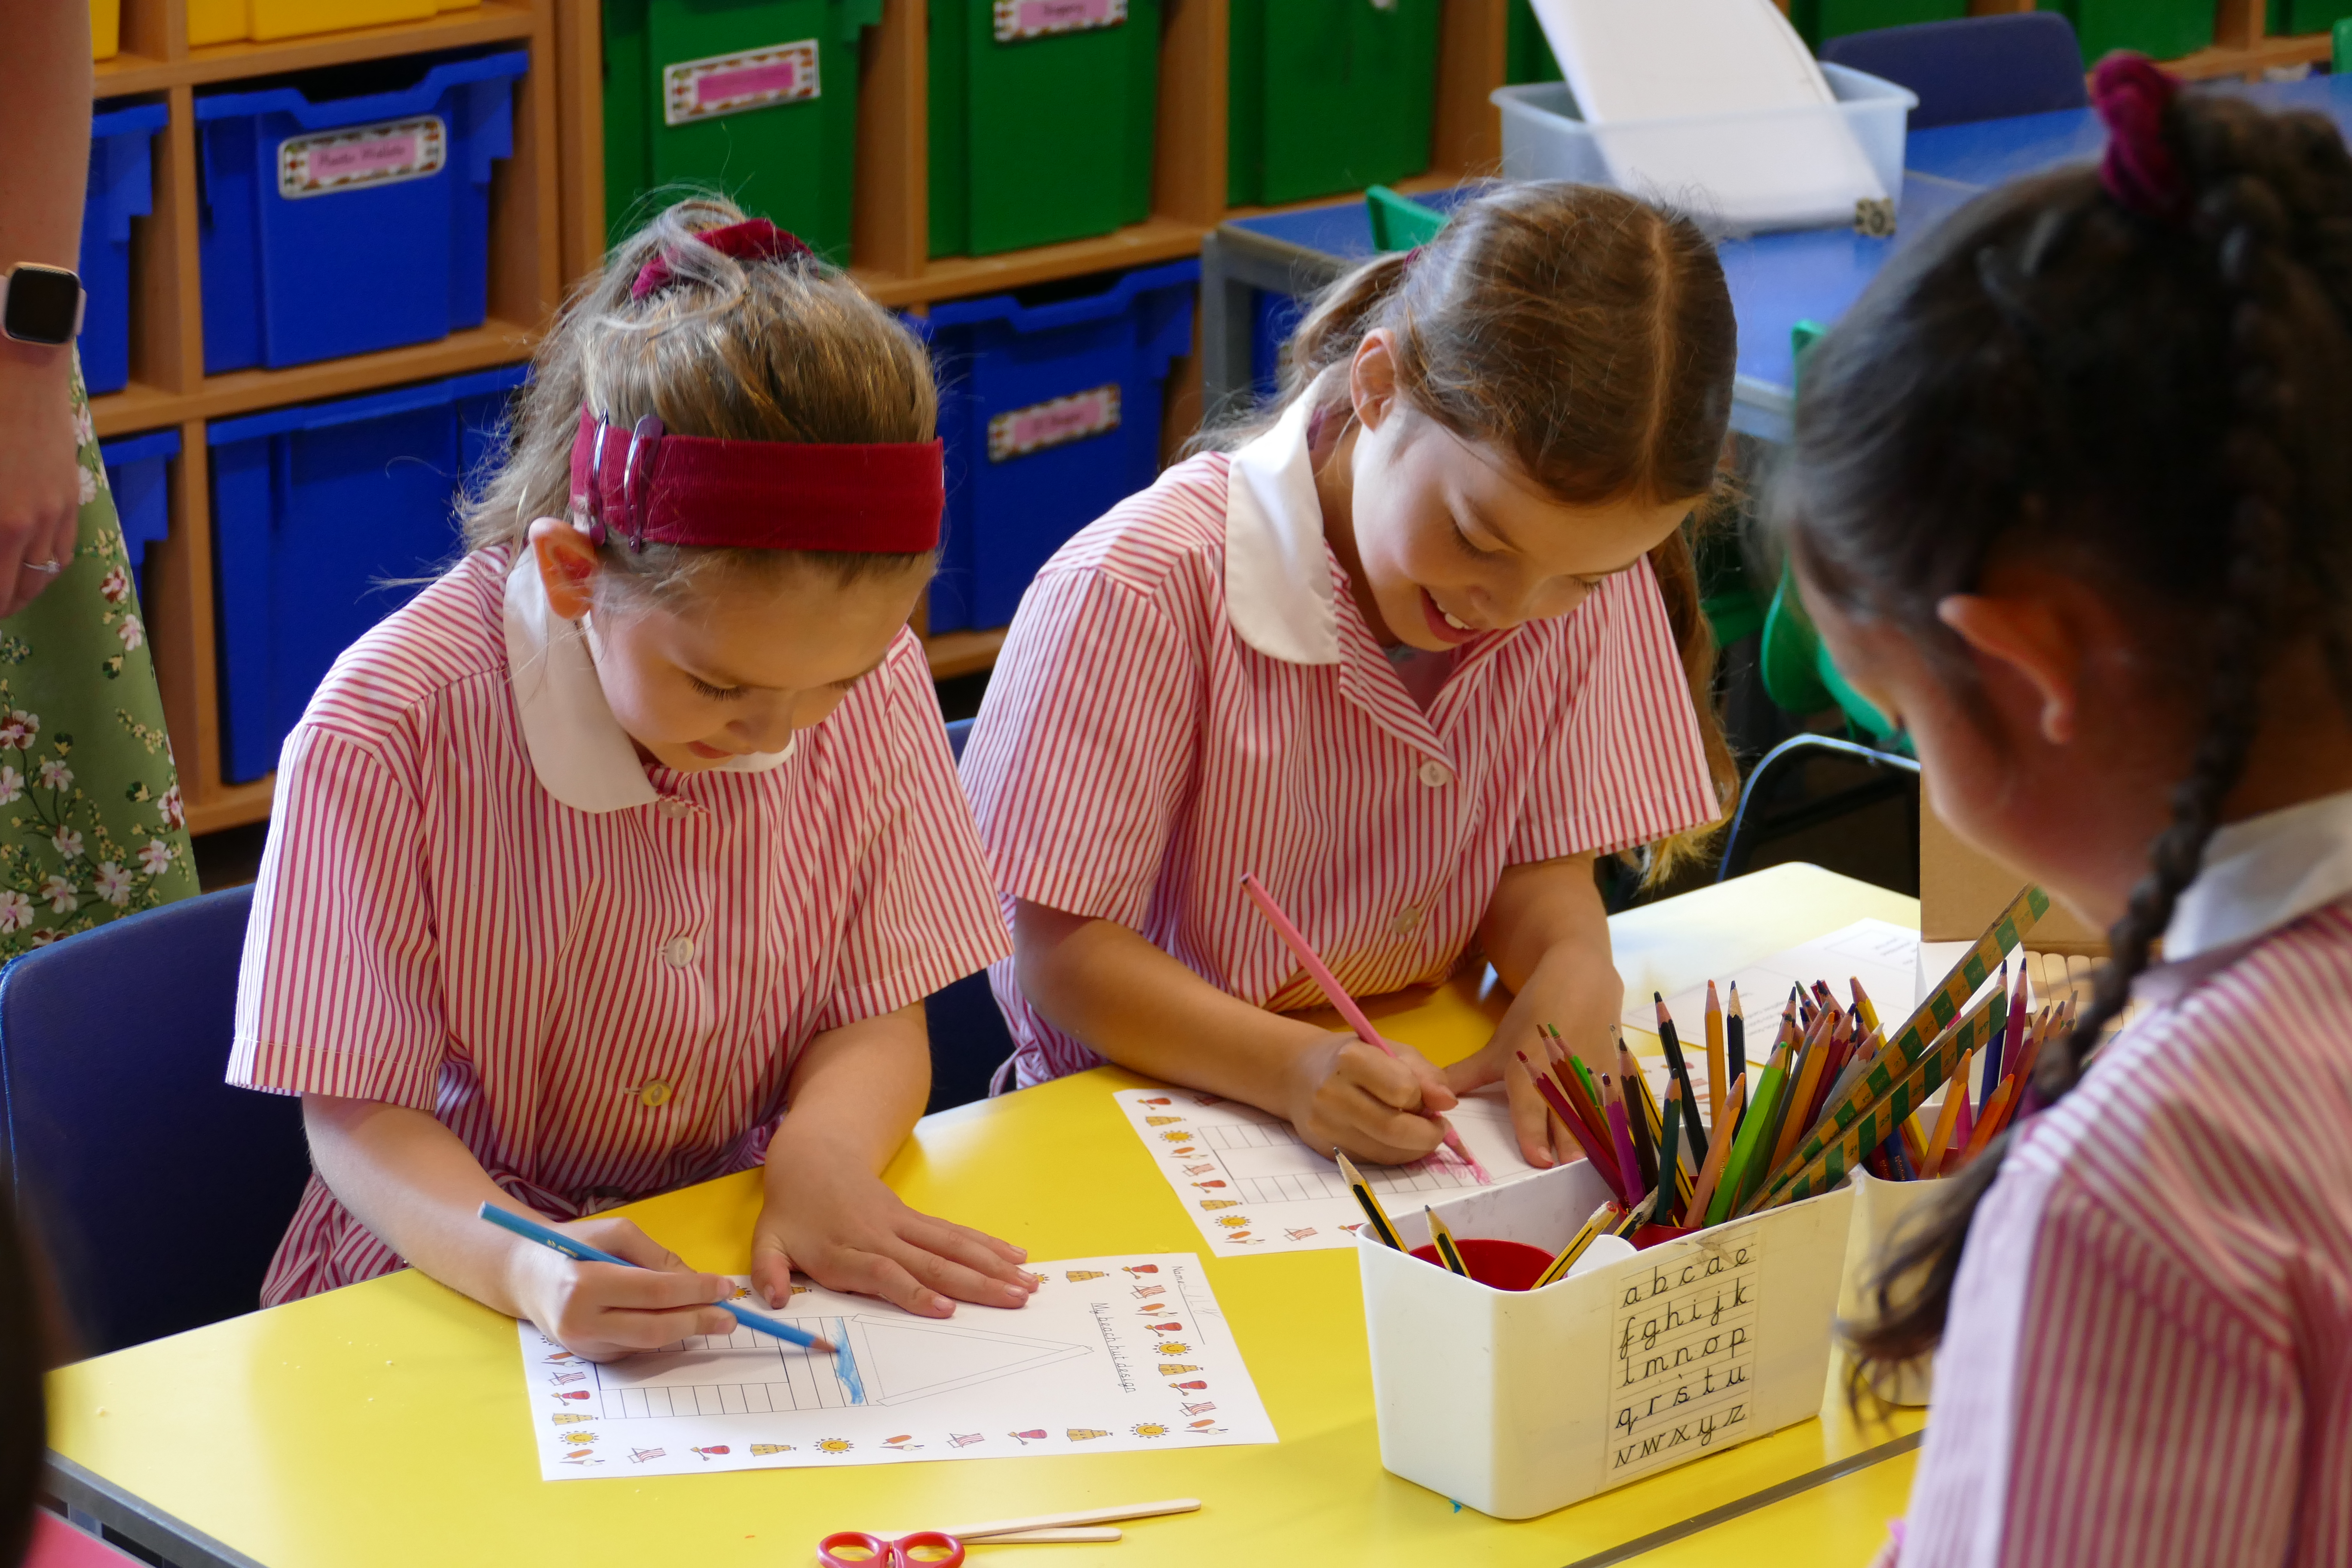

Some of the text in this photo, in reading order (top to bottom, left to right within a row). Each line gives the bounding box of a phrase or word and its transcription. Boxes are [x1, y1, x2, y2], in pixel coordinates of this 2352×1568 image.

[1880, 1114, 1890, 1128] 23
[1623, 1286, 1641, 1308] a
[1651, 1267, 1668, 1297] b
[1679, 1266, 1695, 1286] c
[1733, 1248, 1749, 1267] e
[1089, 1303, 1136, 1393] My beach hut design
[1620, 1278, 1746, 1359] f g h i j k
[1623, 1328, 1746, 1386] l m n o p
[1616, 1367, 1745, 1436] q r s t u
[1614, 1405, 1745, 1469] v w x y z
